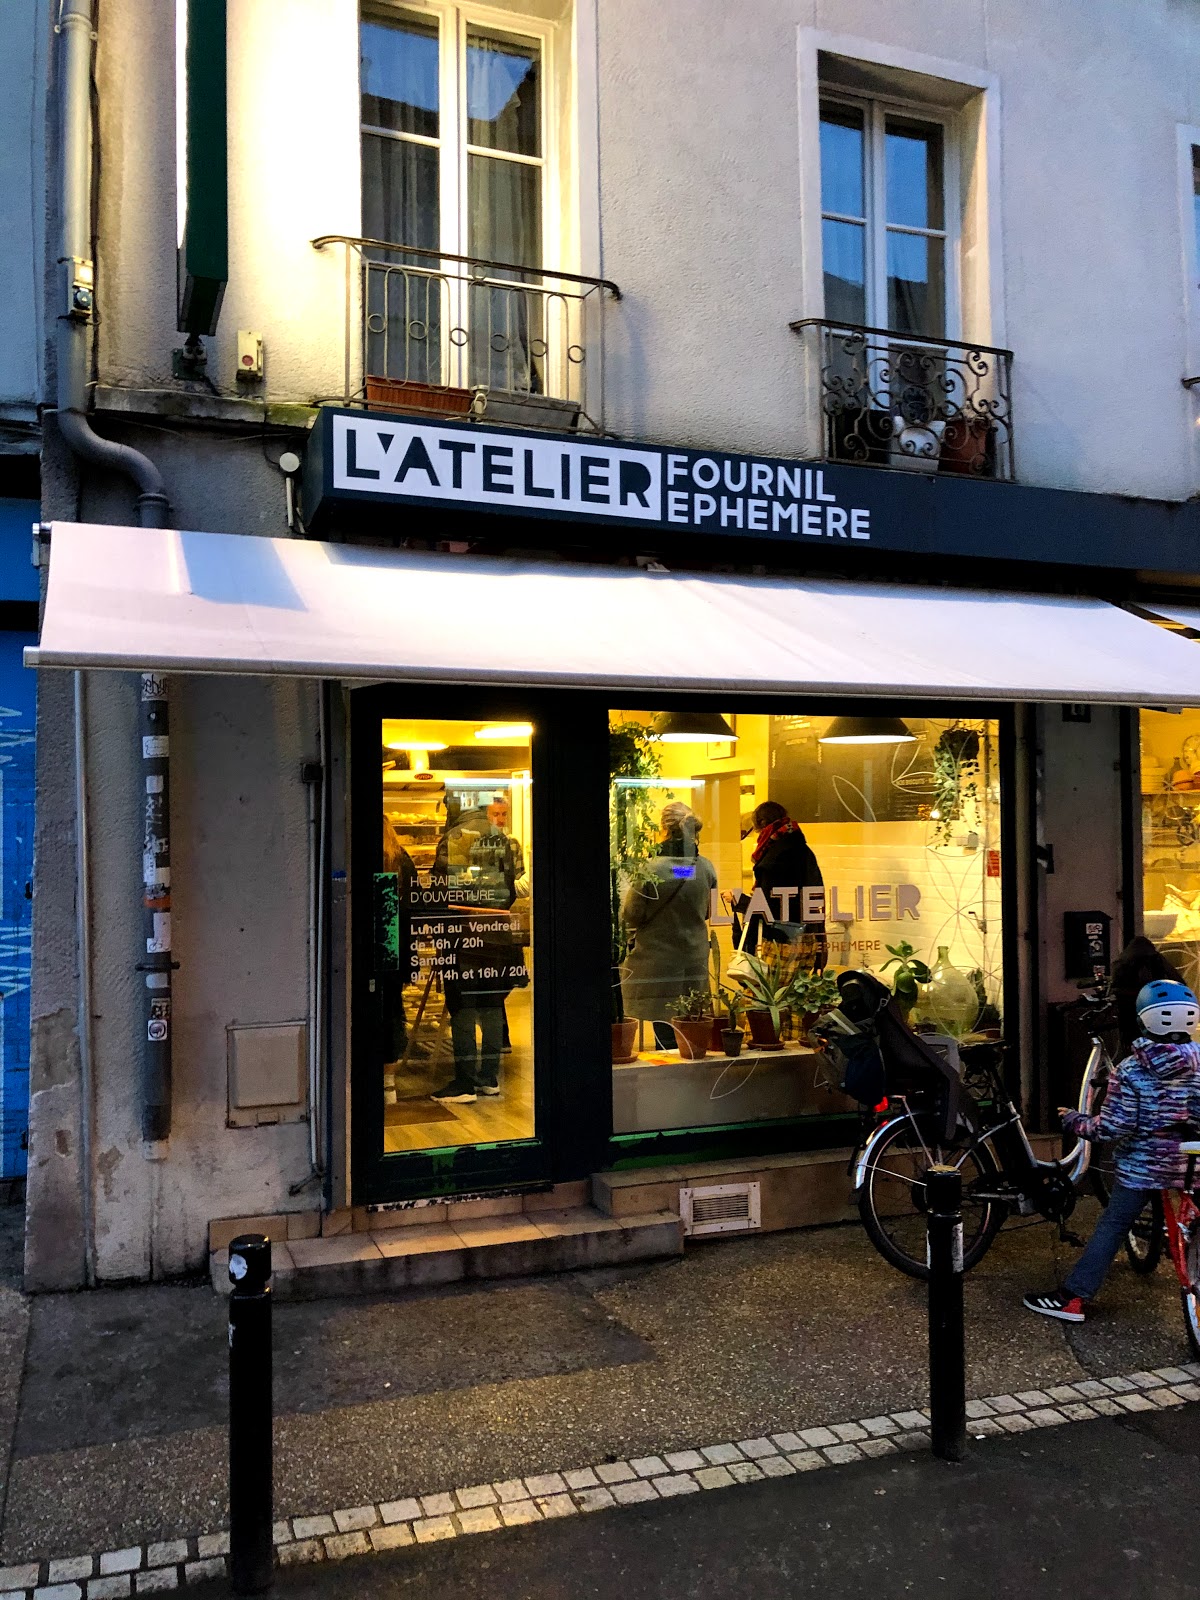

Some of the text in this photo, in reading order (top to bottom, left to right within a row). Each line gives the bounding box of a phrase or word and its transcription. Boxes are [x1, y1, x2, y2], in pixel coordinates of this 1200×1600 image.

[346, 428, 652, 508] L'ATELIER
[667, 454, 836, 502] FOURNIL
[667, 490, 871, 540] EPHEMERE
[410, 875, 472, 887] HORAIRES
[410, 889, 495, 903] D'OUVERTURE
[410, 921, 521, 935] Lundi au Vendredi
[410, 936, 484, 951] de 16h / 20h
[815, 940, 881, 953] EPHEMERE
[410, 953, 457, 966] Samedi
[438, 969, 459, 981] 14h
[462, 968, 474, 979] et
[478, 967, 499, 979] 16h
[509, 965, 529, 977] 20h
